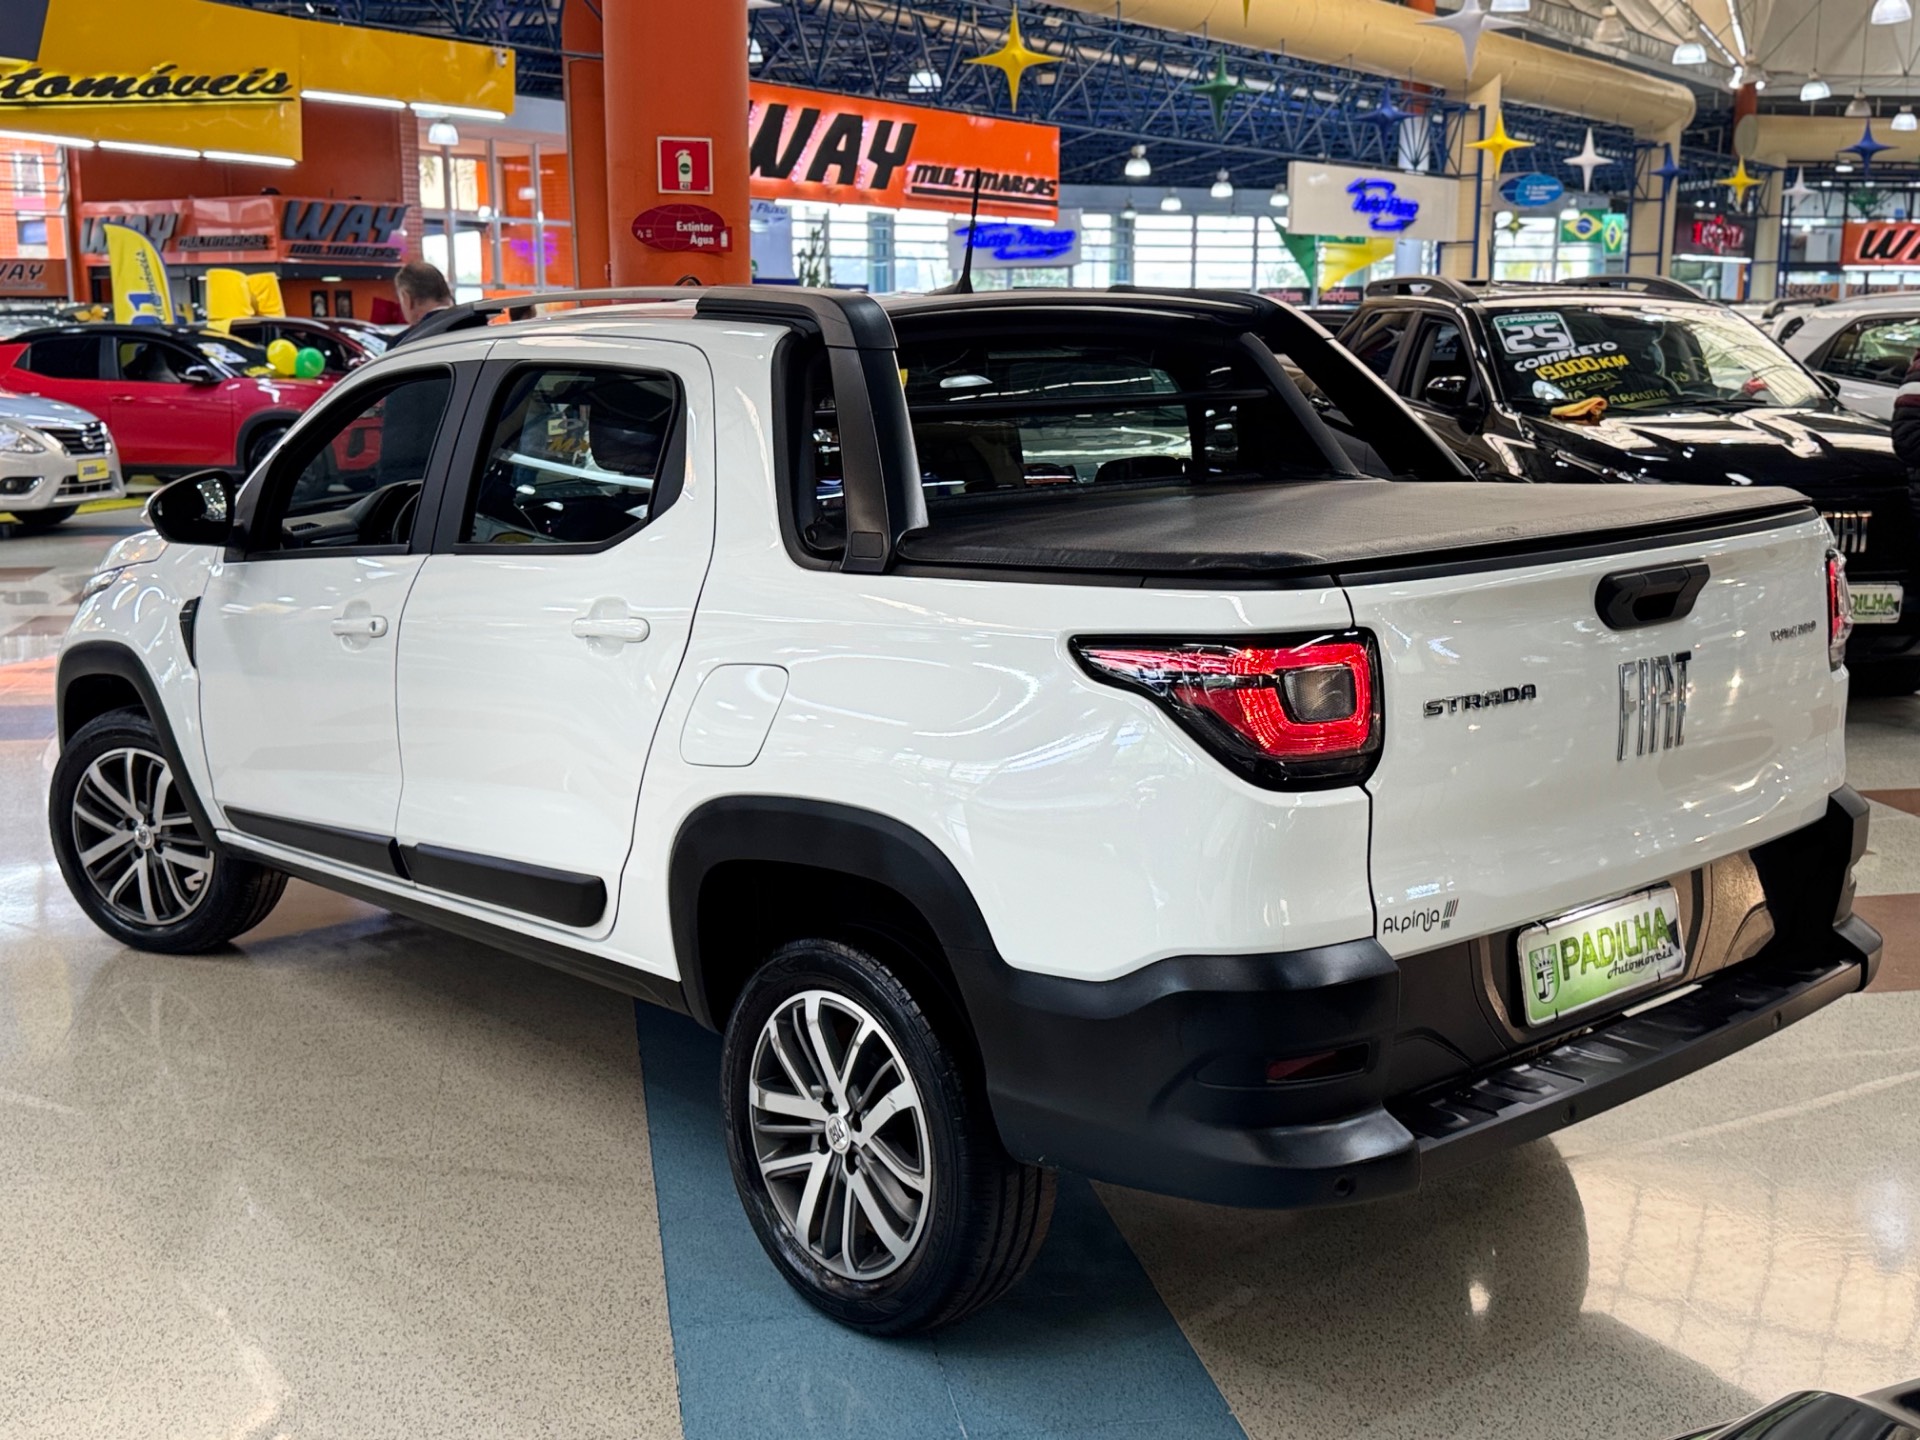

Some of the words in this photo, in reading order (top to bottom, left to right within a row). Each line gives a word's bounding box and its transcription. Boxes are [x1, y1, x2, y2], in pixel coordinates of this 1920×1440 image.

[0, 64, 293, 98] tomóveis
[750, 100, 917, 189] WAY
[283, 200, 409, 243] WAY
[676, 221, 714, 232] Extintor
[690, 232, 715, 247] Água
[1859, 229, 1920, 260] W
[1505, 322, 1570, 350] 25
[1514, 341, 1618, 372] COMPLETO
[1850, 593, 1895, 611] DILHA
[1423, 683, 1537, 718] STRADA
[1617, 650, 1692, 762] FIAT
[1560, 907, 1672, 981] PADILHA
